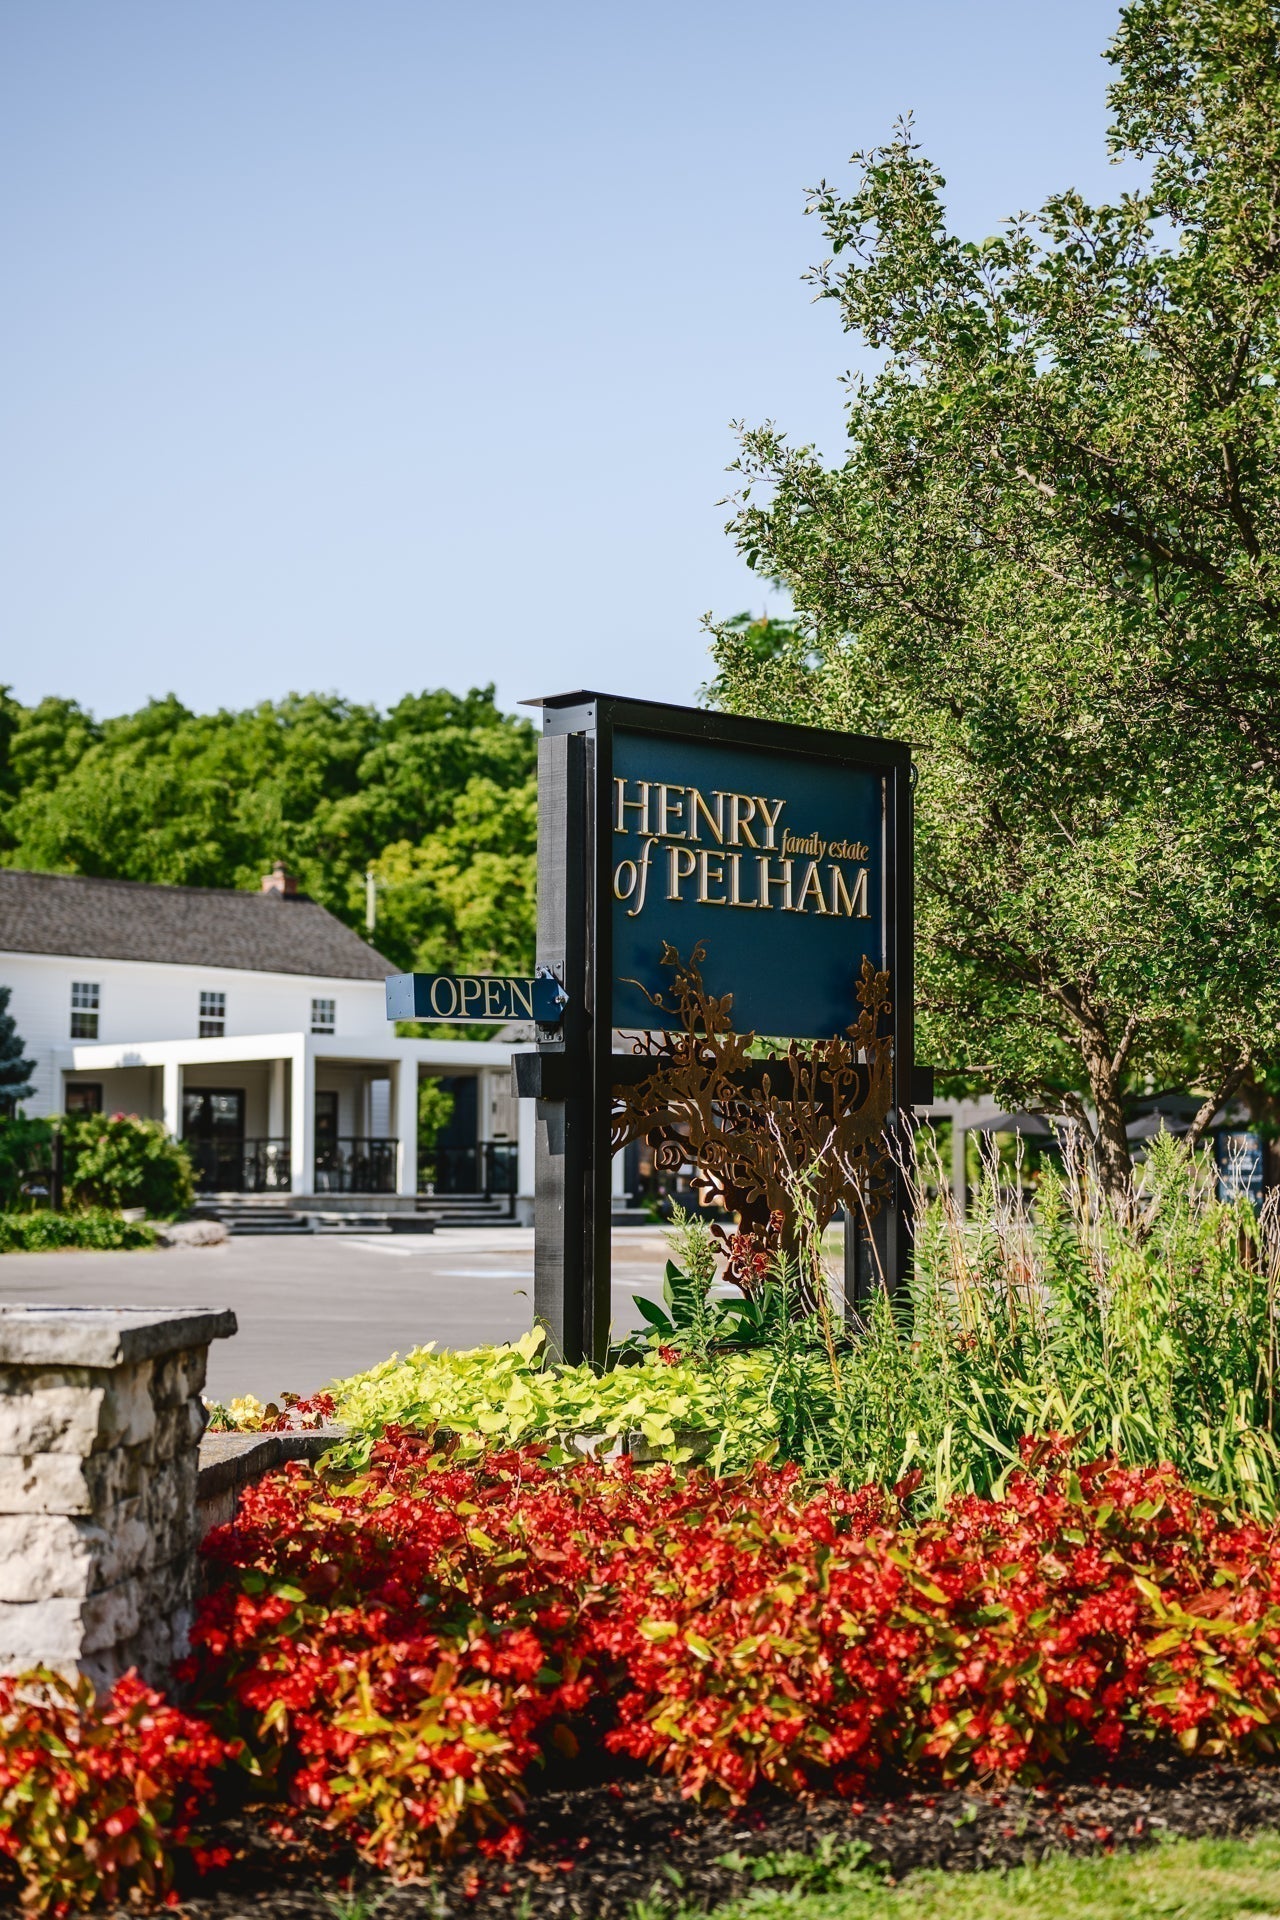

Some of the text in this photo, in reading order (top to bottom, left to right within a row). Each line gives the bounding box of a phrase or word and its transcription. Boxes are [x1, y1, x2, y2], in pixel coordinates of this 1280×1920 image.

[613, 777, 787, 850] HENRY
[781, 827, 870, 863] family estate
[613, 837, 871, 919] of PELHAM
[430, 976, 535, 1018] OPEN
